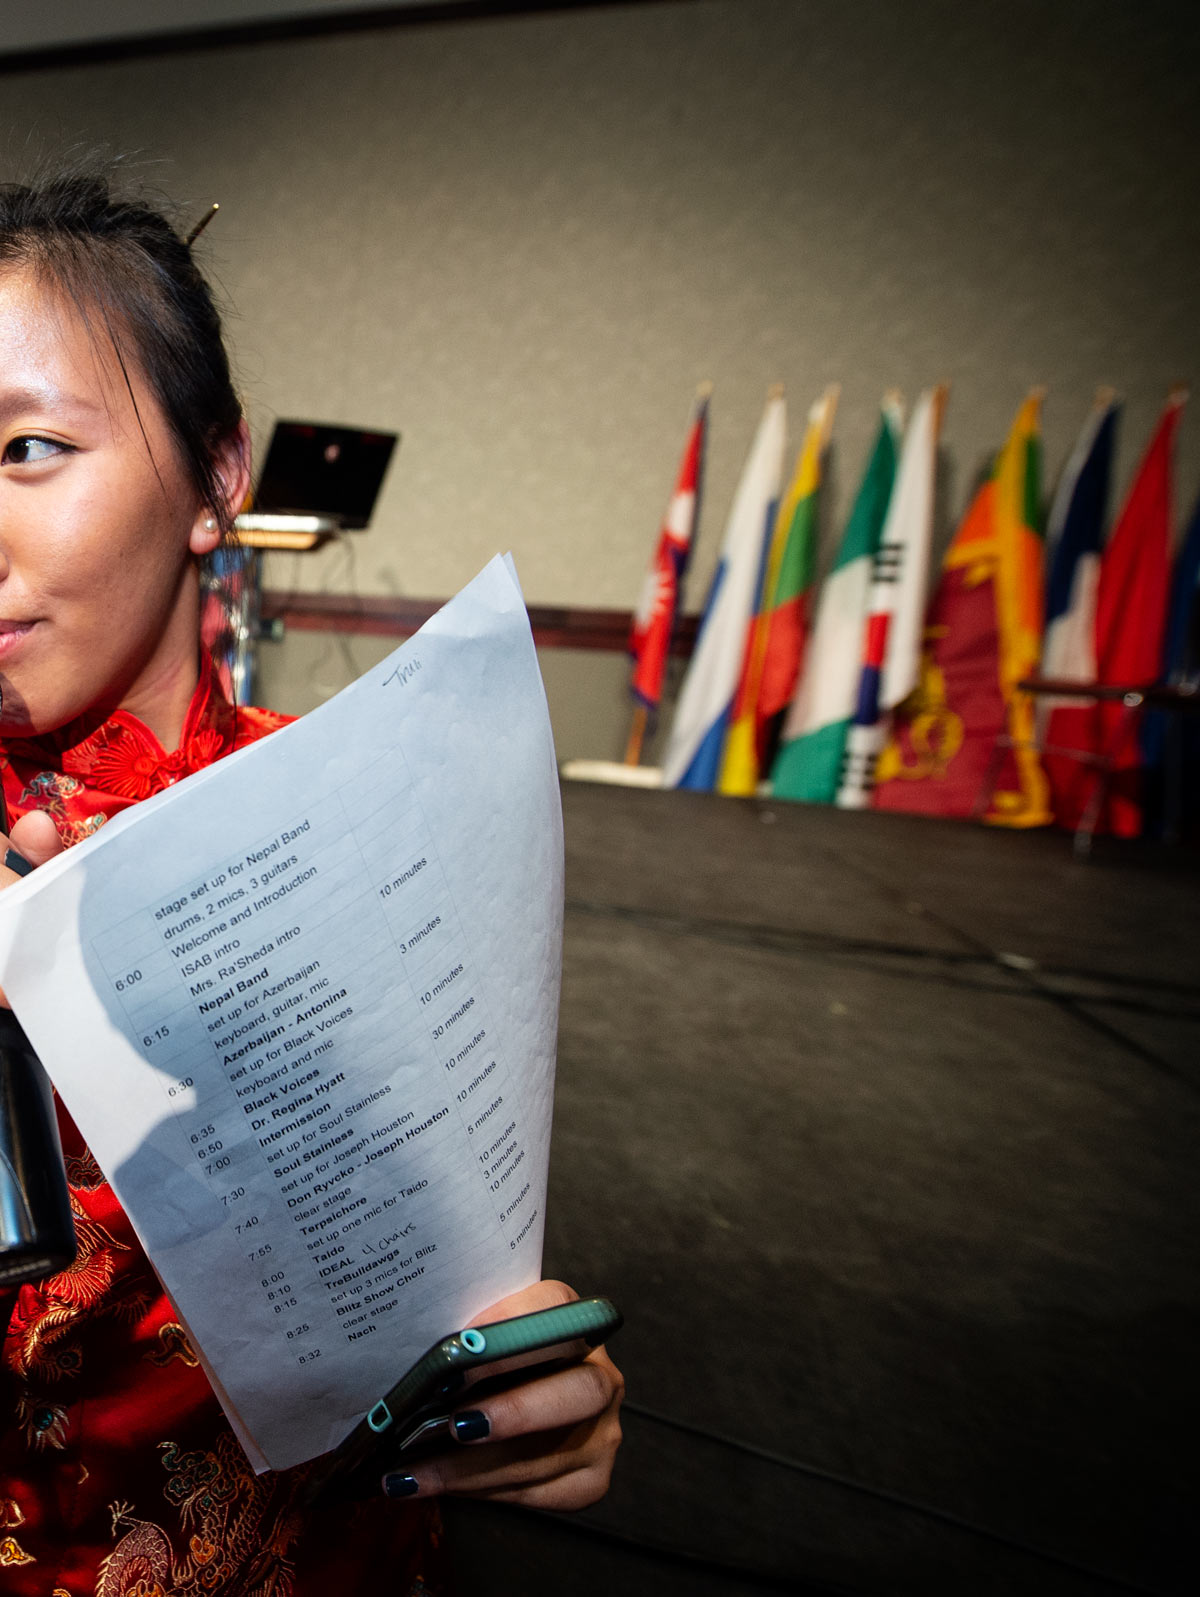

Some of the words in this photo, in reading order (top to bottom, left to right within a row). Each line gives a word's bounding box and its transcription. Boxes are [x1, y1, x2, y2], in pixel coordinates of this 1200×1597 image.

[154, 896, 189, 921] stage
[190, 882, 210, 900] set
[211, 874, 227, 888] up
[227, 862, 244, 877] for
[245, 839, 281, 867] Nepal
[280, 819, 311, 845] Band
[379, 884, 392, 899] 10
[392, 857, 428, 890] minutes
[163, 913, 205, 940] drums,
[205, 903, 216, 916] 2
[217, 888, 249, 909] mics,
[249, 877, 259, 889] 3
[260, 855, 298, 886] guitars
[172, 922, 228, 958] Welcome
[229, 905, 253, 927] and
[252, 866, 318, 912] Introduction
[399, 943, 408, 954] 3
[407, 915, 442, 948] minutes
[180, 953, 213, 978] ISAB
[214, 939, 241, 960] intro
[189, 979, 217, 997] Mrs.
[275, 926, 301, 946] intro
[115, 969, 143, 992] 6:00
[198, 987, 235, 1015] Nepal
[235, 967, 270, 993] Band
[207, 1015, 226, 1033] set
[227, 1007, 243, 1021] up
[243, 995, 259, 1011] for
[262, 960, 321, 1001] Azerbaijan
[420, 991, 432, 1006] 10
[432, 963, 464, 996] minutes
[213, 1012, 271, 1050] keyboard,
[271, 992, 308, 1018] guitar,
[309, 977, 330, 995] mic
[223, 1025, 286, 1067] Azerbaijan
[296, 988, 348, 1025] Antonina
[432, 1025, 444, 1040] 30
[444, 996, 475, 1030] minutes
[142, 1025, 170, 1047] 6:15
[229, 1066, 249, 1082] set
[249, 1058, 265, 1072] up
[265, 1047, 281, 1062] for
[283, 1029, 316, 1053] Black
[315, 1006, 354, 1032] Voices
[445, 1057, 456, 1072] 10
[456, 1029, 486, 1062] minutes
[167, 1076, 194, 1097] 6:30
[235, 1063, 289, 1099] keyboard
[290, 1050, 313, 1070] and
[313, 1039, 335, 1057] mic
[456, 1089, 468, 1103] 10
[467, 1060, 497, 1094] minutes
[243, 1091, 279, 1115] Black
[278, 1068, 321, 1095] Voices
[250, 1117, 271, 1132] Dr.
[270, 1093, 314, 1120] Regina
[314, 1072, 346, 1097] Hyatt
[190, 1123, 216, 1145] 6:35
[258, 1102, 332, 1148] Intermission
[266, 1148, 285, 1164] set
[286, 1140, 301, 1153] up
[301, 1130, 317, 1144] for
[318, 1112, 344, 1134] Soul
[344, 1085, 392, 1118] Stainless
[467, 1124, 474, 1135] 5
[474, 1095, 503, 1129] minutes
[197, 1140, 223, 1160] 6:50
[273, 1157, 302, 1179] Soul
[302, 1128, 355, 1163] Stainless
[280, 1179, 299, 1194] set
[299, 1172, 315, 1184] up
[315, 1160, 330, 1175] for
[332, 1137, 370, 1165] Joseph
[370, 1111, 415, 1142] Houston
[286, 1191, 312, 1209] Don
[363, 1137, 405, 1165] Joseph
[404, 1107, 450, 1141] Houston
[478, 1150, 490, 1164] 10
[489, 1121, 517, 1155] minutes
[483, 1169, 491, 1180] 3
[490, 1140, 518, 1174] minutes
[204, 1155, 232, 1176] 7:00
[489, 1179, 500, 1193] 10
[500, 1150, 525, 1184] minutes
[220, 1186, 246, 1207] 7:30
[293, 1204, 320, 1223] clear
[322, 1187, 352, 1209] stage
[299, 1197, 368, 1236] Terpsichore
[306, 1237, 325, 1251] set
[325, 1230, 340, 1242] up
[341, 1218, 362, 1234] one
[363, 1206, 383, 1222] mic
[382, 1195, 397, 1209] for
[397, 1179, 429, 1199] Taido
[499, 1212, 506, 1223] 5
[506, 1182, 531, 1216] minutes
[234, 1215, 259, 1235] 7:40
[509, 1240, 516, 1250] 5
[516, 1209, 538, 1244] minutes
[247, 1243, 272, 1262] 7:55
[311, 1245, 345, 1264] Taido
[318, 1257, 356, 1279] IDEAL
[330, 1291, 348, 1304] set
[349, 1284, 363, 1295] up
[364, 1279, 373, 1289] 3
[374, 1266, 399, 1284] mics
[399, 1256, 413, 1269] for
[414, 1243, 438, 1260] Blitz
[260, 1270, 285, 1288] 8:00
[267, 1284, 292, 1301] 8:10
[335, 1301, 363, 1317] Blitz
[363, 1284, 395, 1305] Show
[396, 1266, 425, 1287] Choir
[273, 1297, 298, 1314] 8:15
[342, 1313, 368, 1329] clear
[369, 1299, 399, 1317] stage
[286, 1323, 310, 1340] 8:25
[349, 1325, 377, 1342] Nach
[298, 1348, 322, 1365] 8:32
